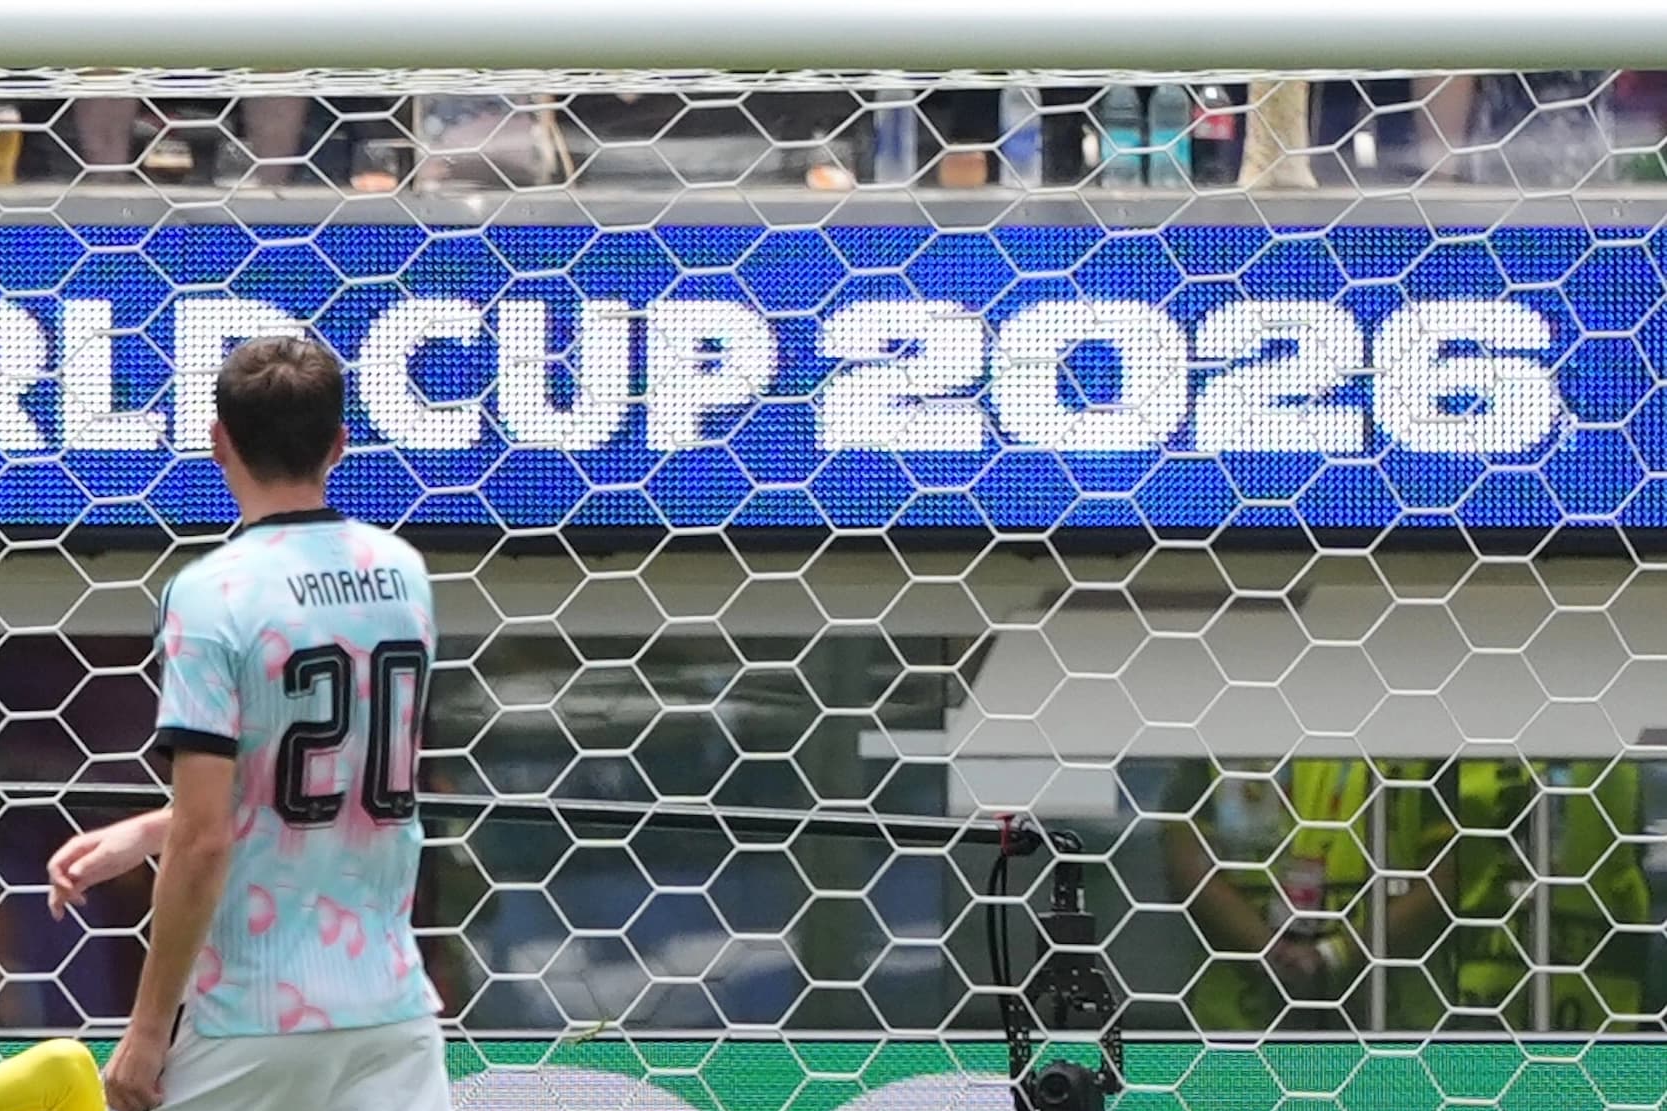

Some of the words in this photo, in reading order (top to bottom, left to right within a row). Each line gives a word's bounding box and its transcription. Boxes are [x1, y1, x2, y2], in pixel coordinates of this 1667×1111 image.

[356, 297, 780, 450] CUP
[814, 297, 1558, 454] 2026
[287, 568, 408, 606] VANAKEN
[275, 639, 428, 822] 20
